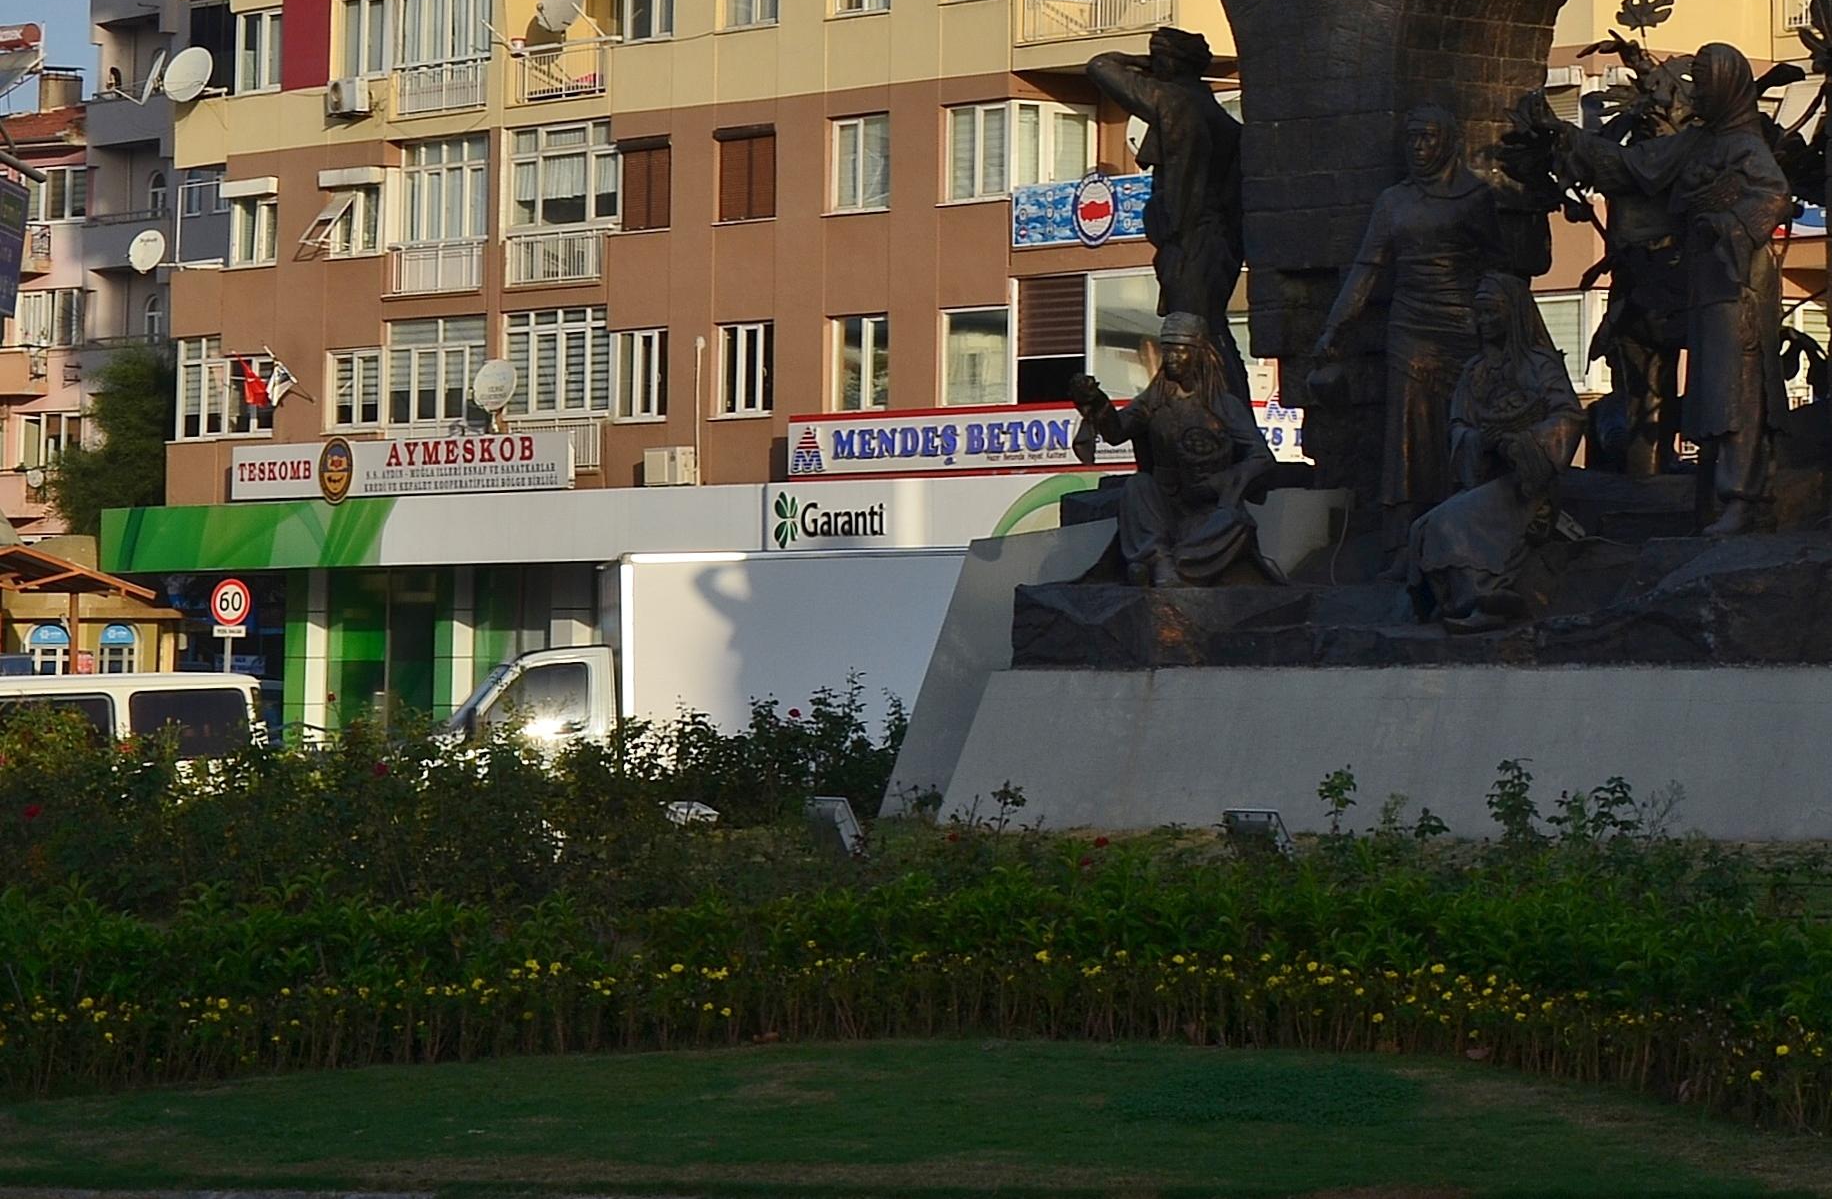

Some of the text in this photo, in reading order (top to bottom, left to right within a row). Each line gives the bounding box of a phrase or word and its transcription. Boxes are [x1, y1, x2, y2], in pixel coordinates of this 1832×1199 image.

[385, 436, 534, 467] AYMESKOB
[832, 419, 1071, 466] MENDEŞ BETON
[238, 460, 312, 482] TESKOMB
[801, 502, 886, 538] Garanti
[219, 591, 242, 612] 60
